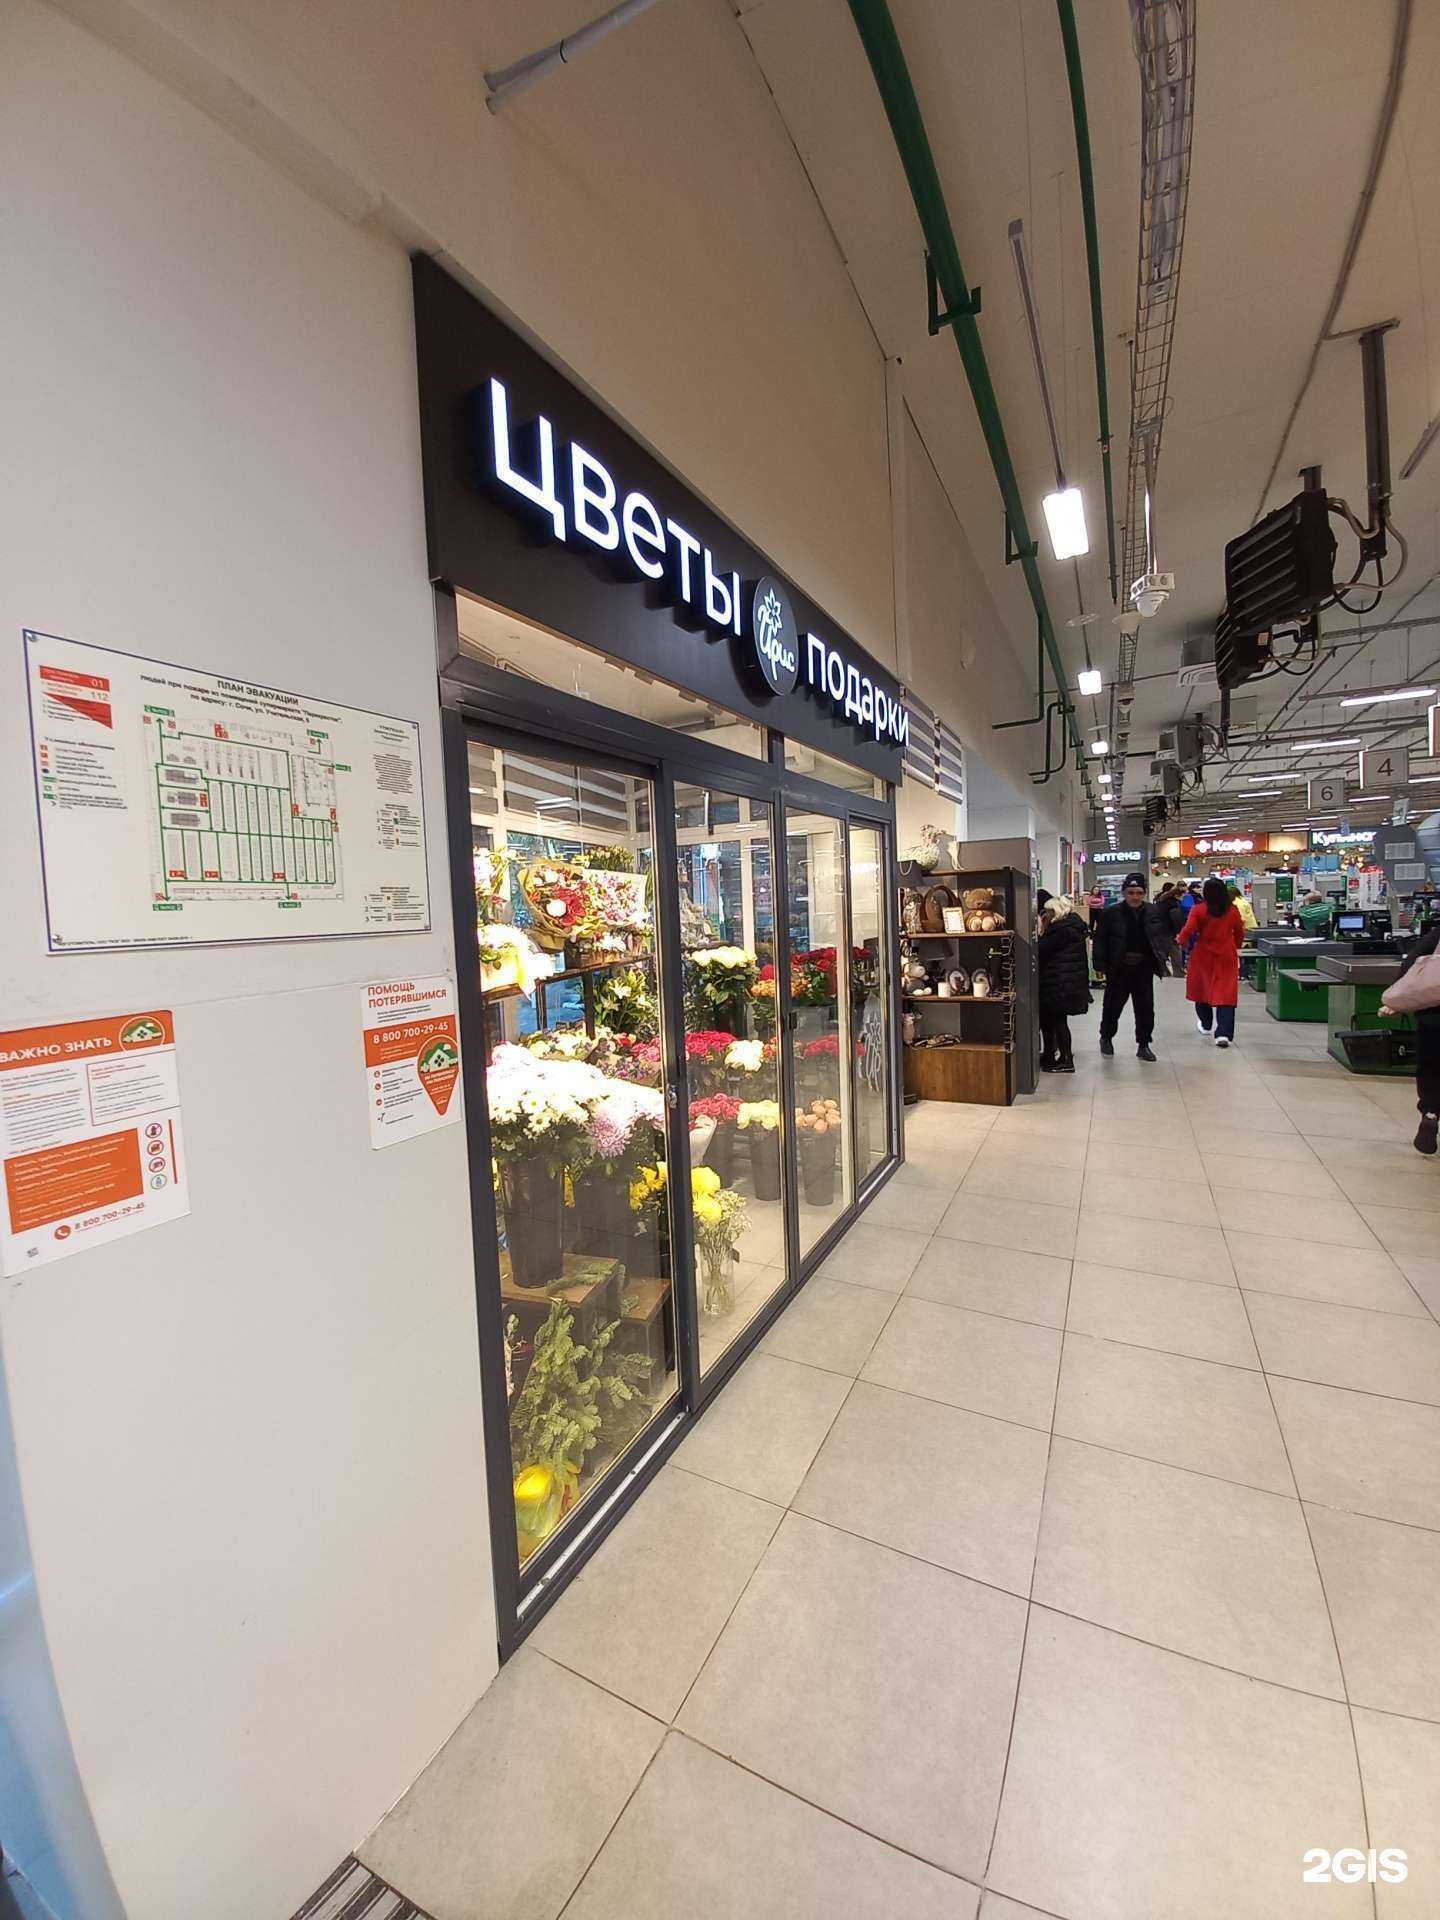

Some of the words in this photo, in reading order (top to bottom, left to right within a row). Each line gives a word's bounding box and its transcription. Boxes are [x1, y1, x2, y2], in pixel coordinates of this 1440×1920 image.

[758, 604, 795, 680] Ирис
[91, 679, 104, 689] 01
[168, 680, 182, 690] при
[91, 692, 109, 701] 112
[217, 680, 244, 694] ПЛАН
[246, 687, 299, 706] ЭВАКУАЦИИ
[1377, 758, 1394, 776] 4
[1321, 786, 1333, 801] 6
[1212, 839, 1254, 853] Кафе
[1093, 851, 1141, 863] аптека
[368, 982, 415, 996] ПОМОЩЬ
[369, 989, 447, 1008] ПОТЕРЯВШИМСЯ
[373, 1034, 380, 1044] 8
[382, 1031, 401, 1042] 800
[404, 1021, 449, 1038] 700-29-45
[0, 1044, 61, 1063] ВАЖНО
[64, 1037, 112, 1053] ЗНАТЬ
